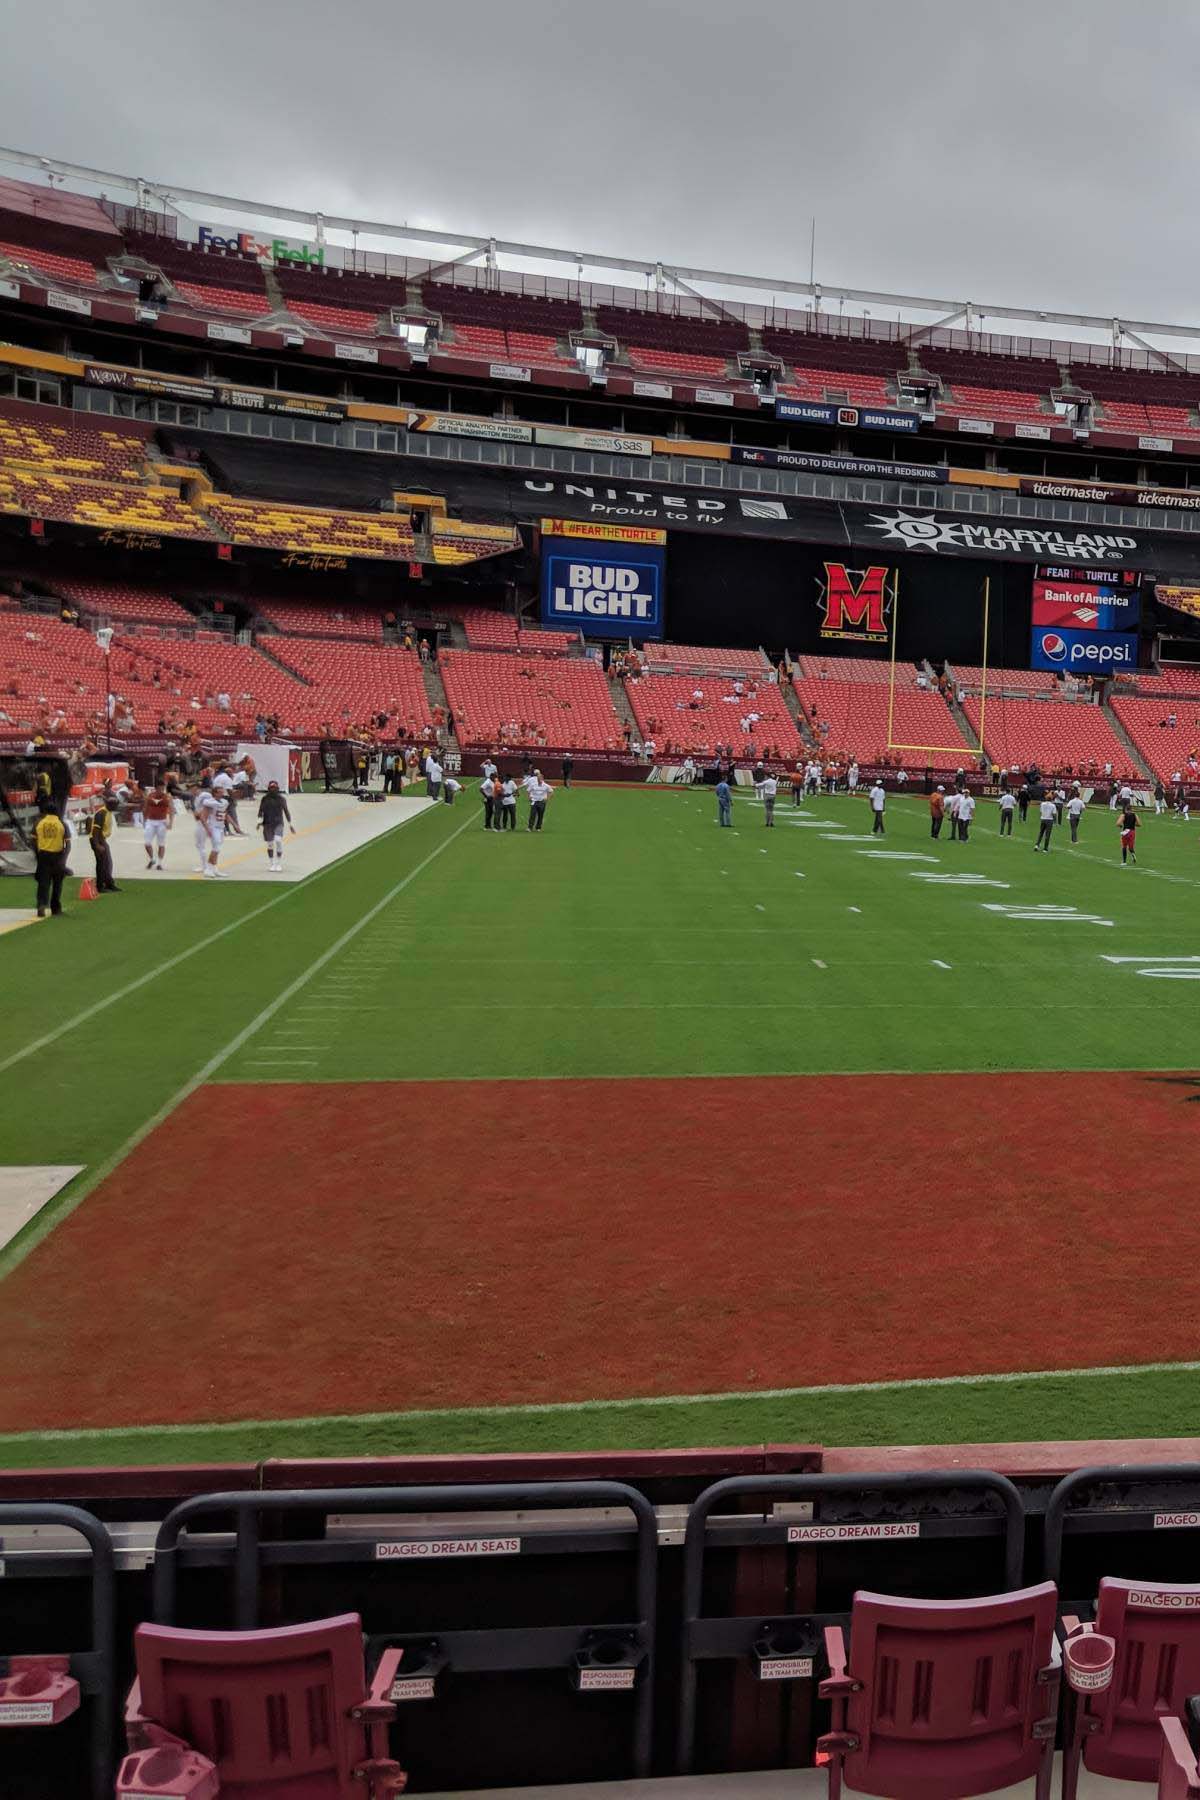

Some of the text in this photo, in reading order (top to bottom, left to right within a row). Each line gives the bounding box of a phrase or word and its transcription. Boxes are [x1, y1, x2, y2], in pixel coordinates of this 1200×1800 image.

[199, 227, 325, 265] FedExField
[780, 405, 831, 420] BUD LIGHT
[465, 422, 496, 431] ANALYTICS
[865, 415, 914, 429] BUD LIGHT
[460, 427, 501, 438] WASHINGTON
[502, 432, 530, 441] REDSKINS
[623, 441, 643, 452] sas
[777, 455, 938, 478] PROUD TO DELIVER FOR THE REDSKINS.
[524, 480, 726, 511] UNITED
[1032, 482, 1114, 501] ticketmaster
[590, 502, 724, 525] Proud to fly
[960, 523, 1138, 550] MARYLAND
[569, 564, 640, 592] BUD
[555, 587, 653, 617] LIGHT
[1045, 589, 1129, 607] Bank of America
[1071, 643, 1130, 663] pepsi
[1155, 1514, 1197, 1526] DIAGEO
[790, 1525, 917, 1539] DIAGEO DREAM SEATS
[378, 1540, 518, 1556] DIAGEO DREAM SEATS
[1130, 1592, 1182, 1606] DIAGEO
[762, 1661, 810, 1670] RESPONSIBILITY
[582, 1671, 634, 1680] RESPONSIBILITY
[392, 1681, 433, 1690] PONSIBILITY
